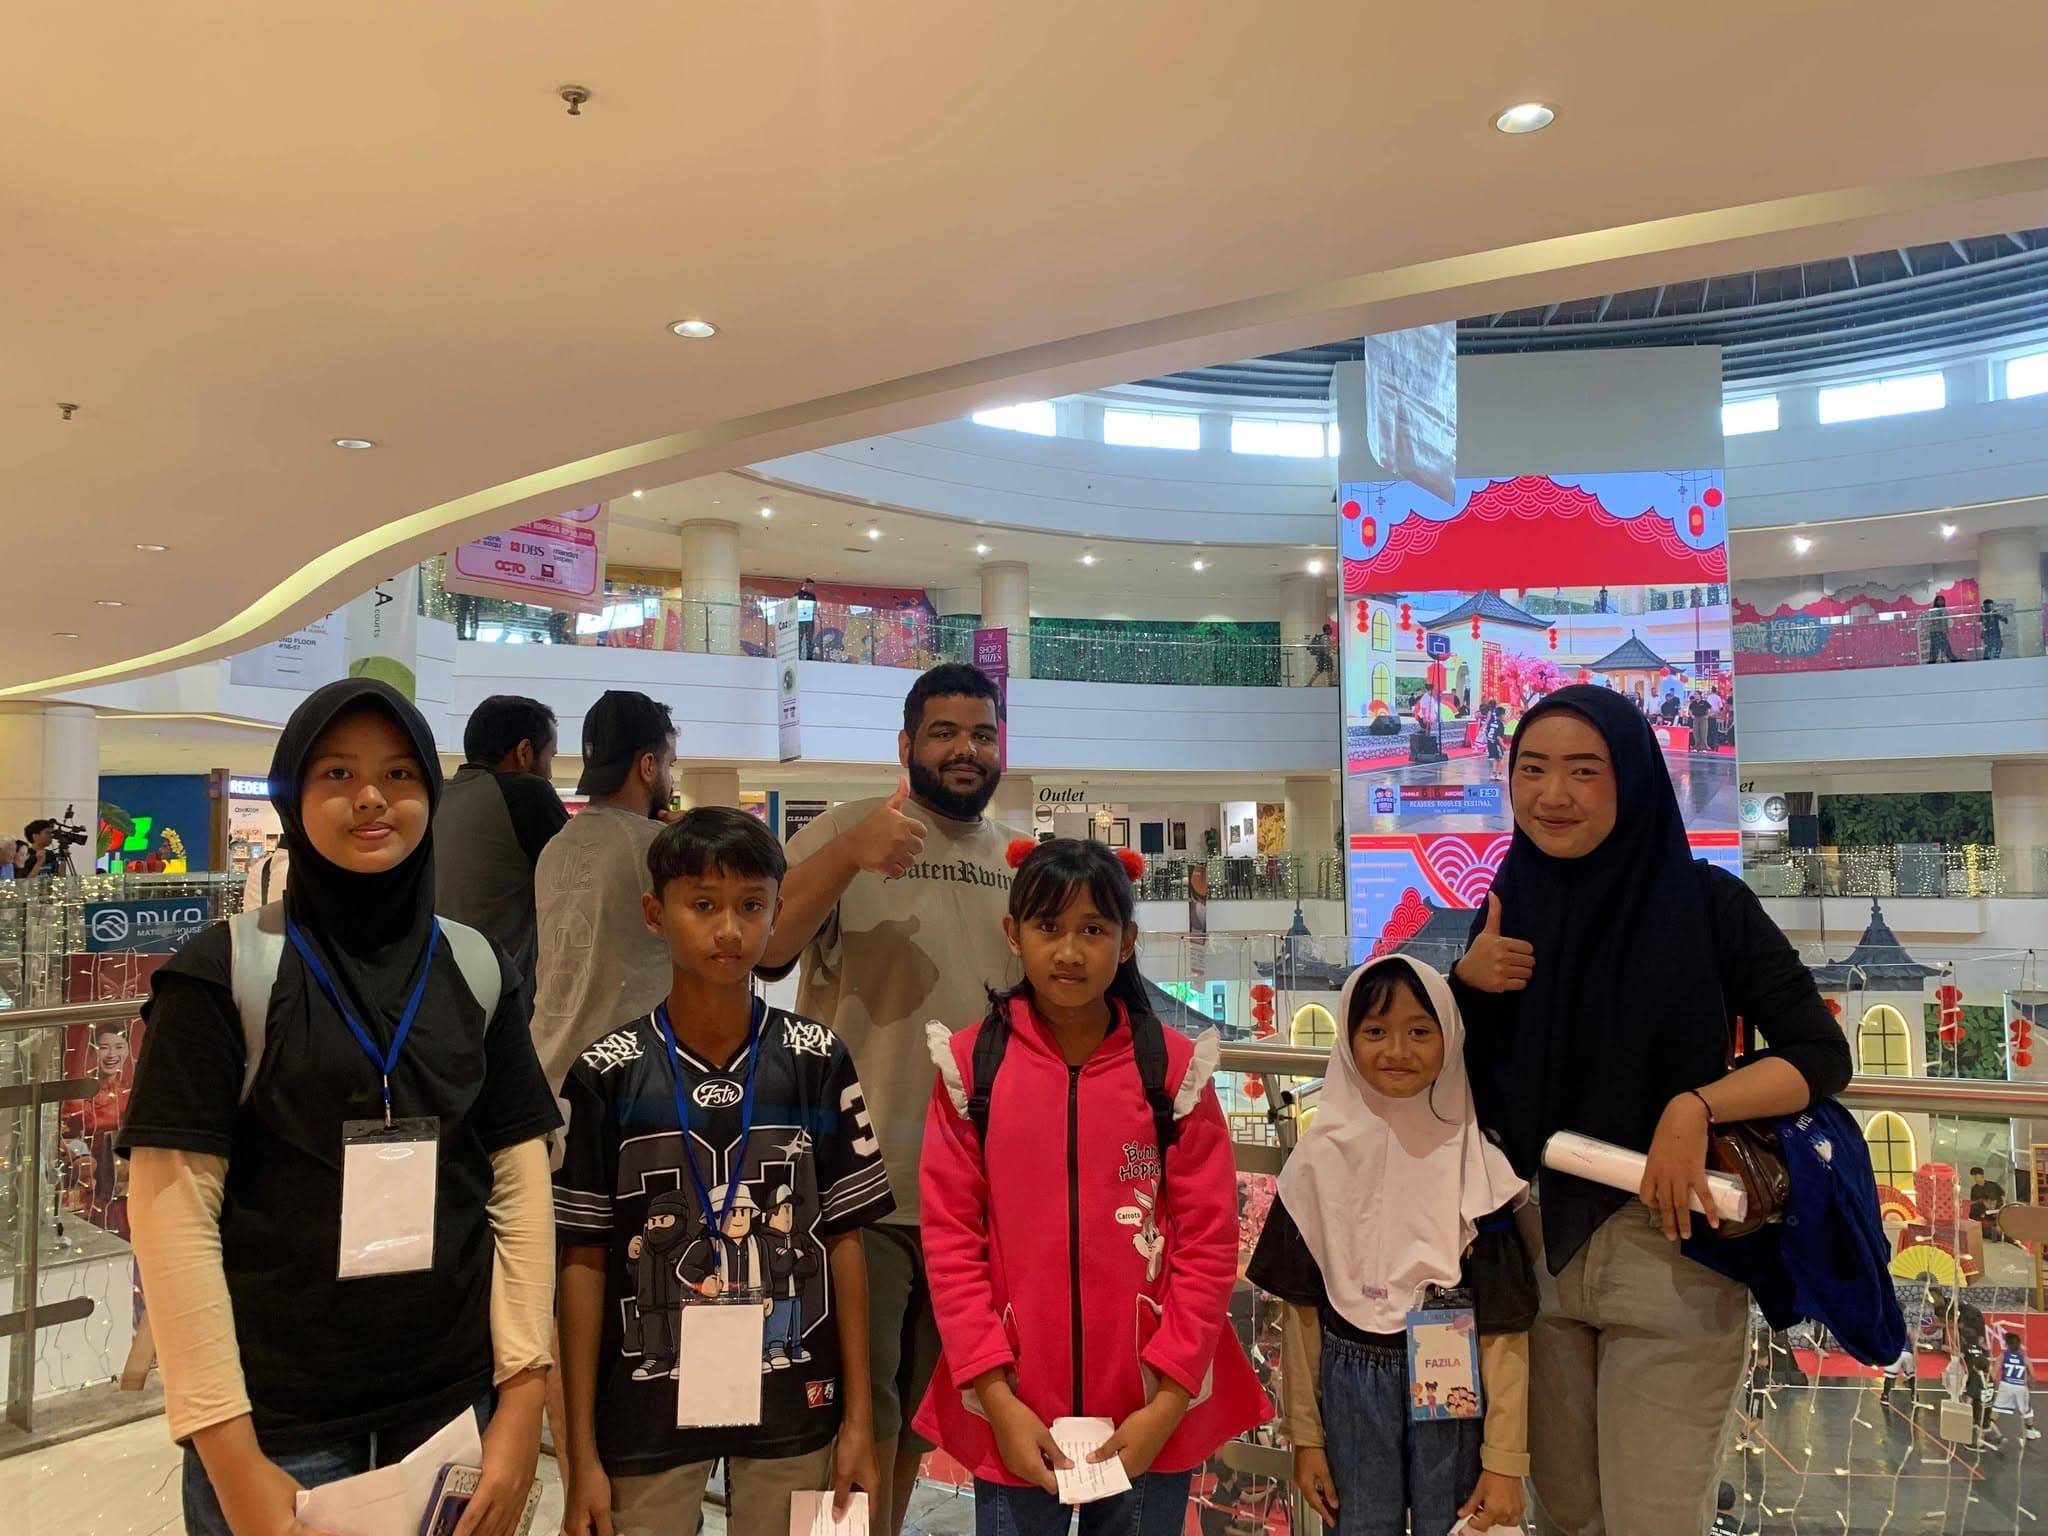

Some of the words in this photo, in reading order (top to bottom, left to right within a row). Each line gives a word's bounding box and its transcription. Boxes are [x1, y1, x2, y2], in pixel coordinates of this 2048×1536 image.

[522, 543, 545, 556] DBS
[495, 560, 526, 573] OCTO
[1039, 787, 1085, 802] Outlet
[136, 907, 202, 926] miro
[840, 1082, 880, 1157] 3
[1117, 1211, 1141, 1220] Carrots
[1425, 1358, 1461, 1369] FAZILA
[2004, 1363, 2025, 1379] 77
